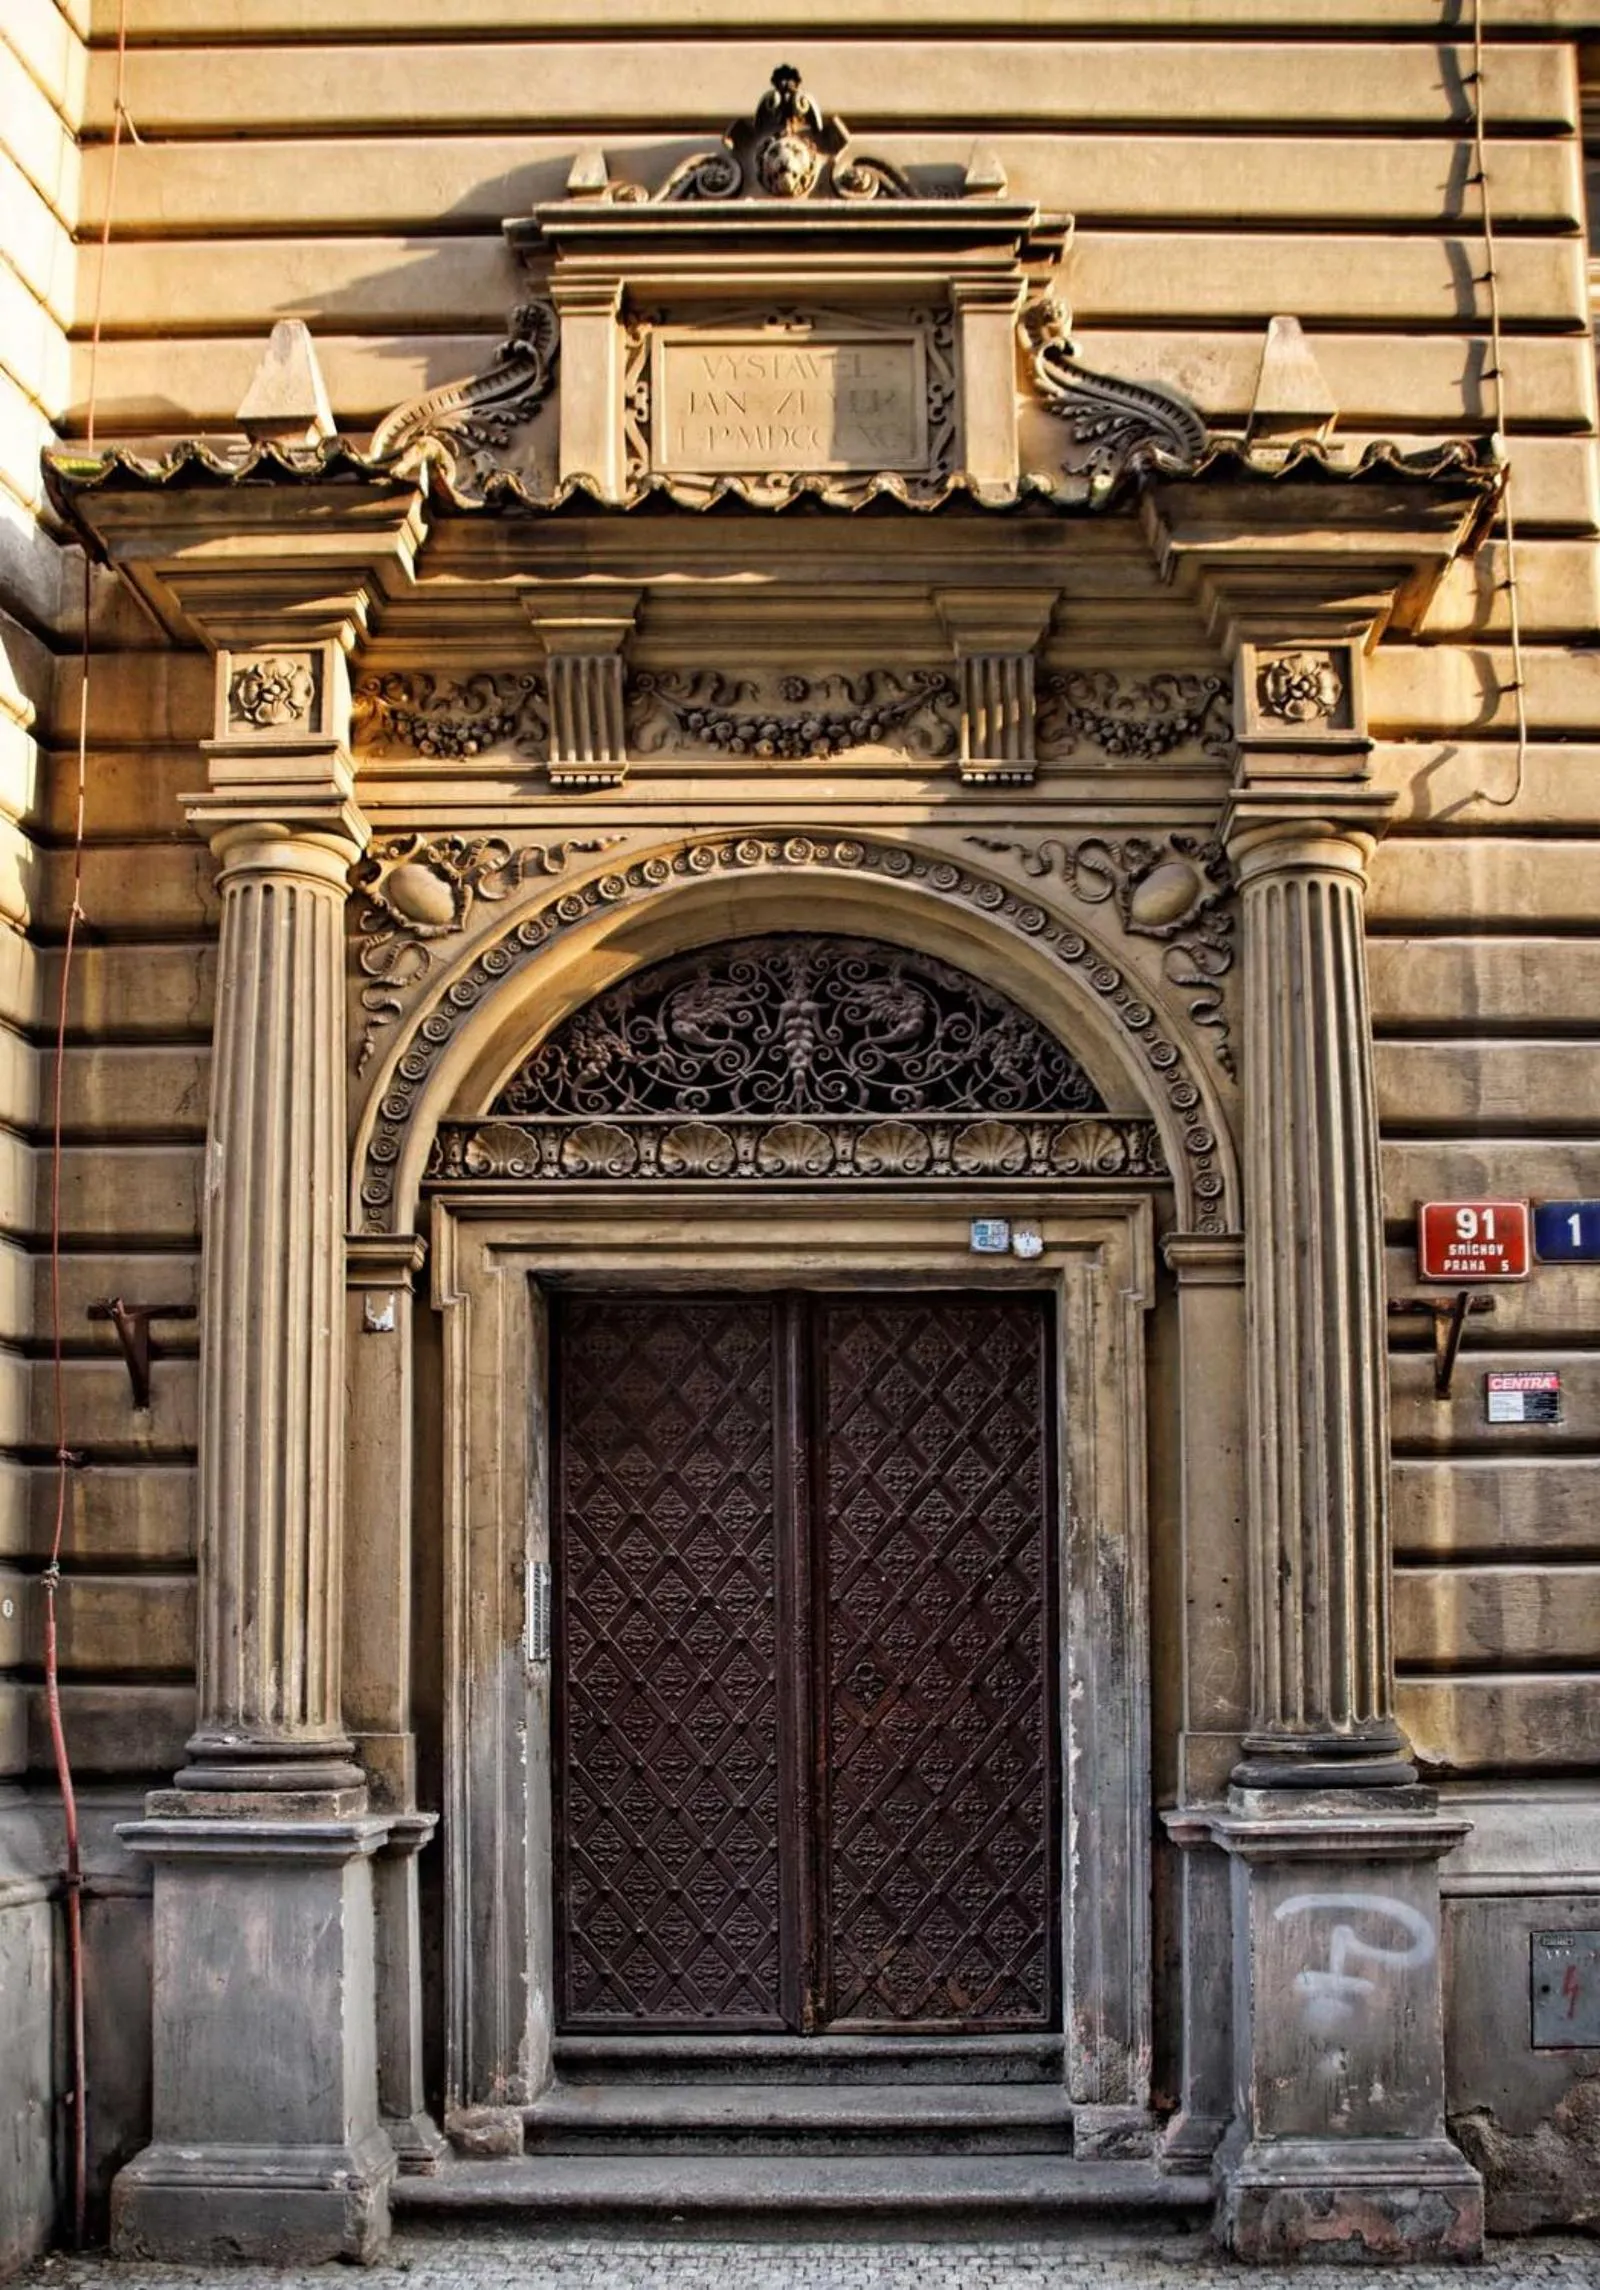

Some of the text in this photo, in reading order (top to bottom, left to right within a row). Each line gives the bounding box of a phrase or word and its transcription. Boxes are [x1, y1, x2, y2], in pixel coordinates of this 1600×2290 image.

[1456, 1208, 1495, 1240] 91
[1567, 1213, 1581, 1246] 1
[1448, 1240, 1504, 1256] SMÍCHOV
[1443, 1260, 1510, 1272] PRAHA 5
[1491, 1376, 1551, 1390] CENTRA
